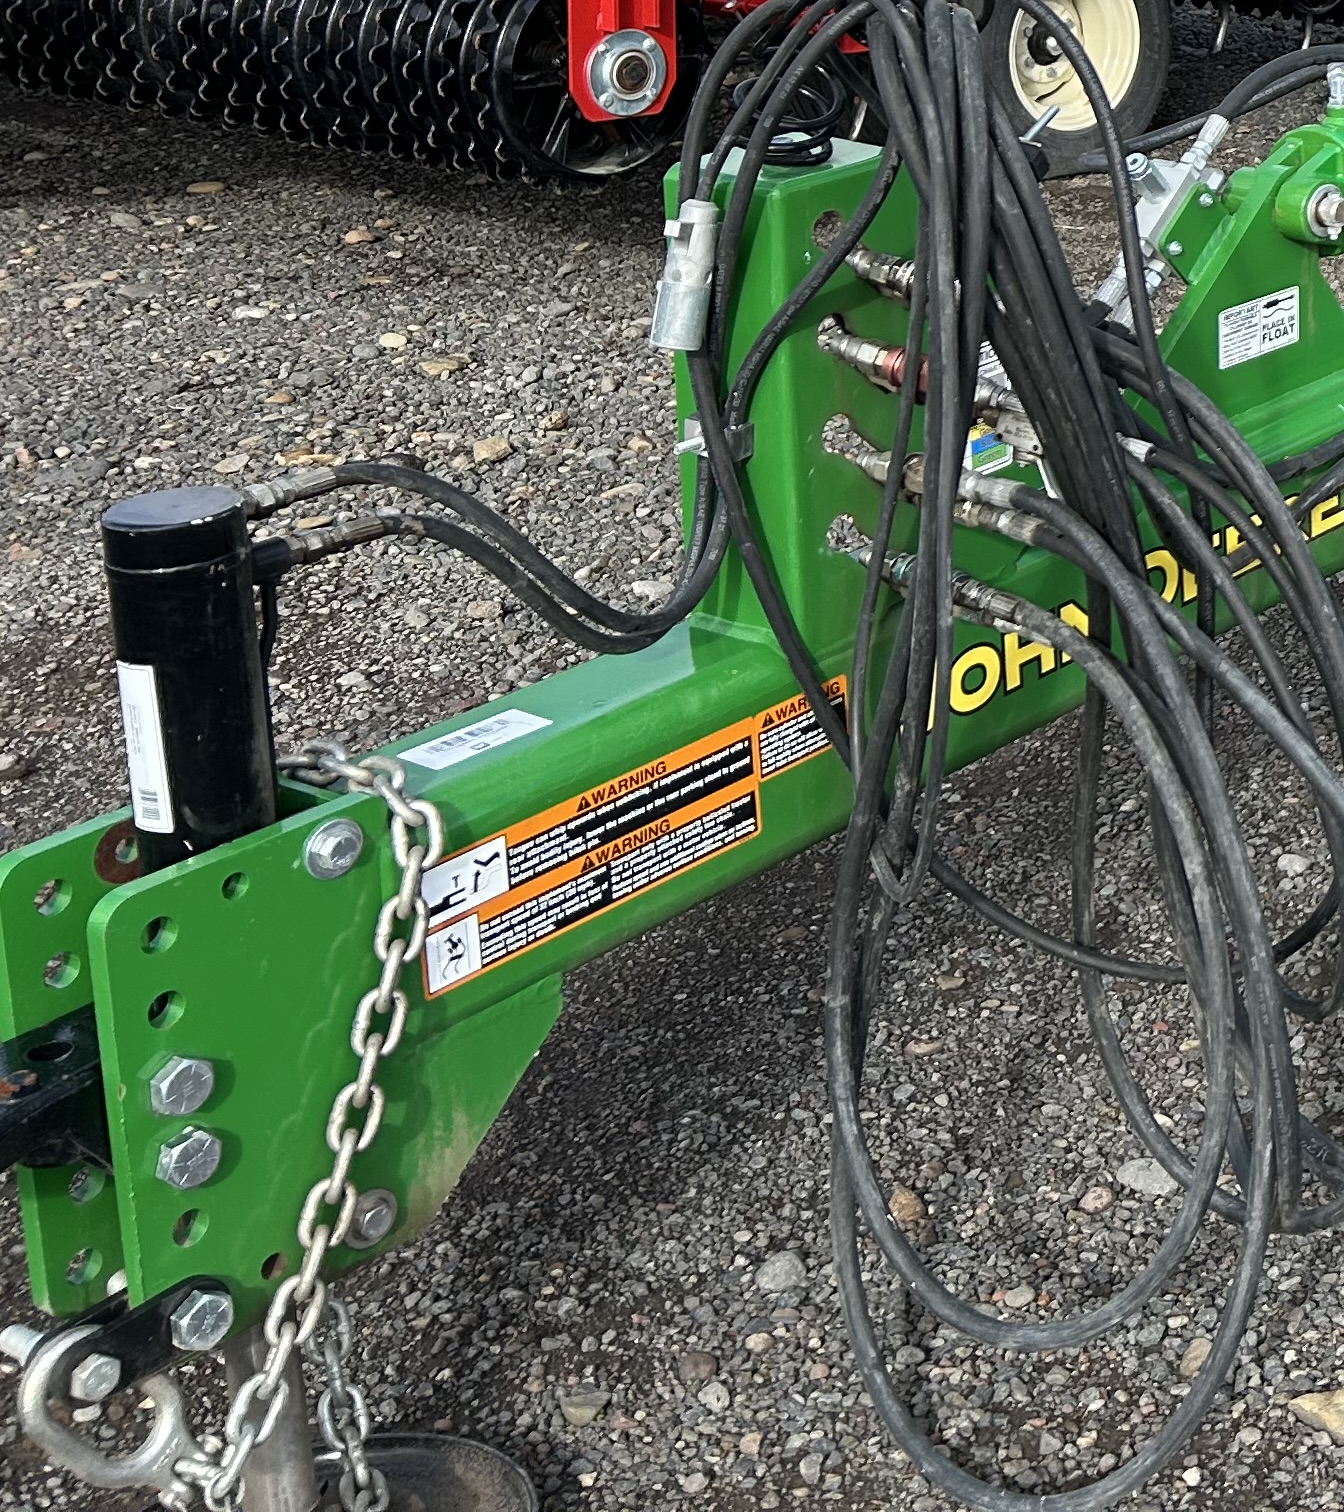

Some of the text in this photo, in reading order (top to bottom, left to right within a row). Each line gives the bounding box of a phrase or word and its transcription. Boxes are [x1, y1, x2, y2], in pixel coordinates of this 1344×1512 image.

[1262, 314, 1296, 333] PLACE IN
[1262, 323, 1296, 344] FLOAT
[591, 760, 667, 805] WARNING
[595, 819, 671, 865] WARNING
